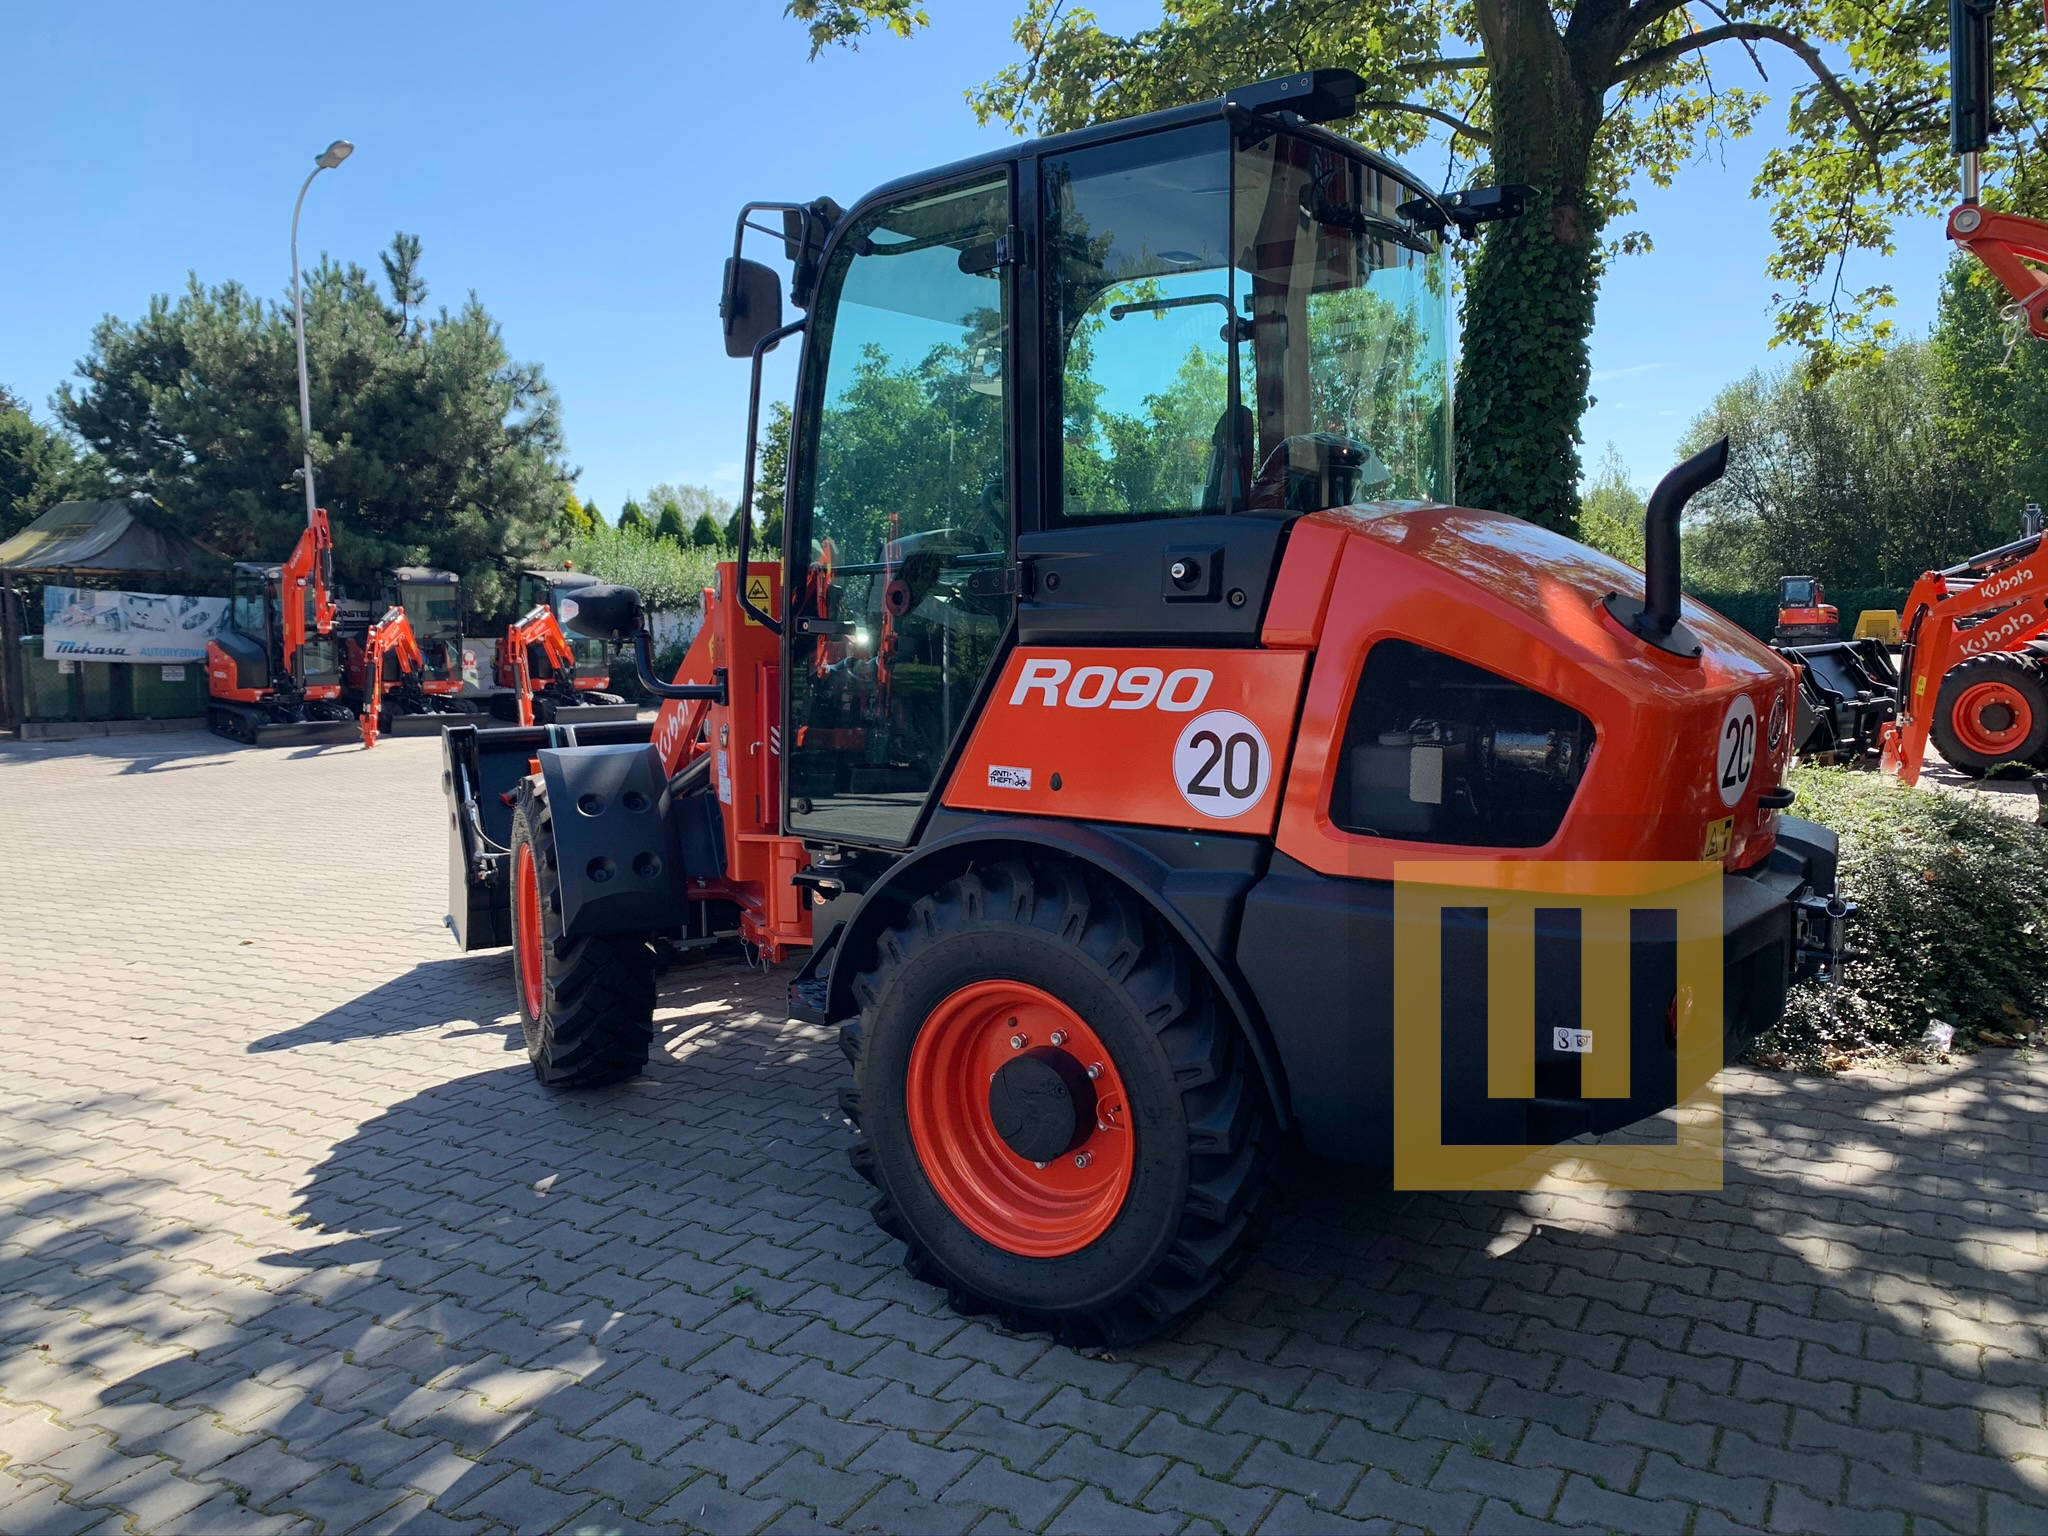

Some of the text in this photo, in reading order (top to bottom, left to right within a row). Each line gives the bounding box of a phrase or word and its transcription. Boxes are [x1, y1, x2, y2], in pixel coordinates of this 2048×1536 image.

[1981, 569, 2034, 598] Kubota
[1960, 613, 2034, 655] Kubota
[1008, 659, 1214, 712] R090
[1187, 730, 1259, 799] 20
[1721, 714, 1754, 788] 20
